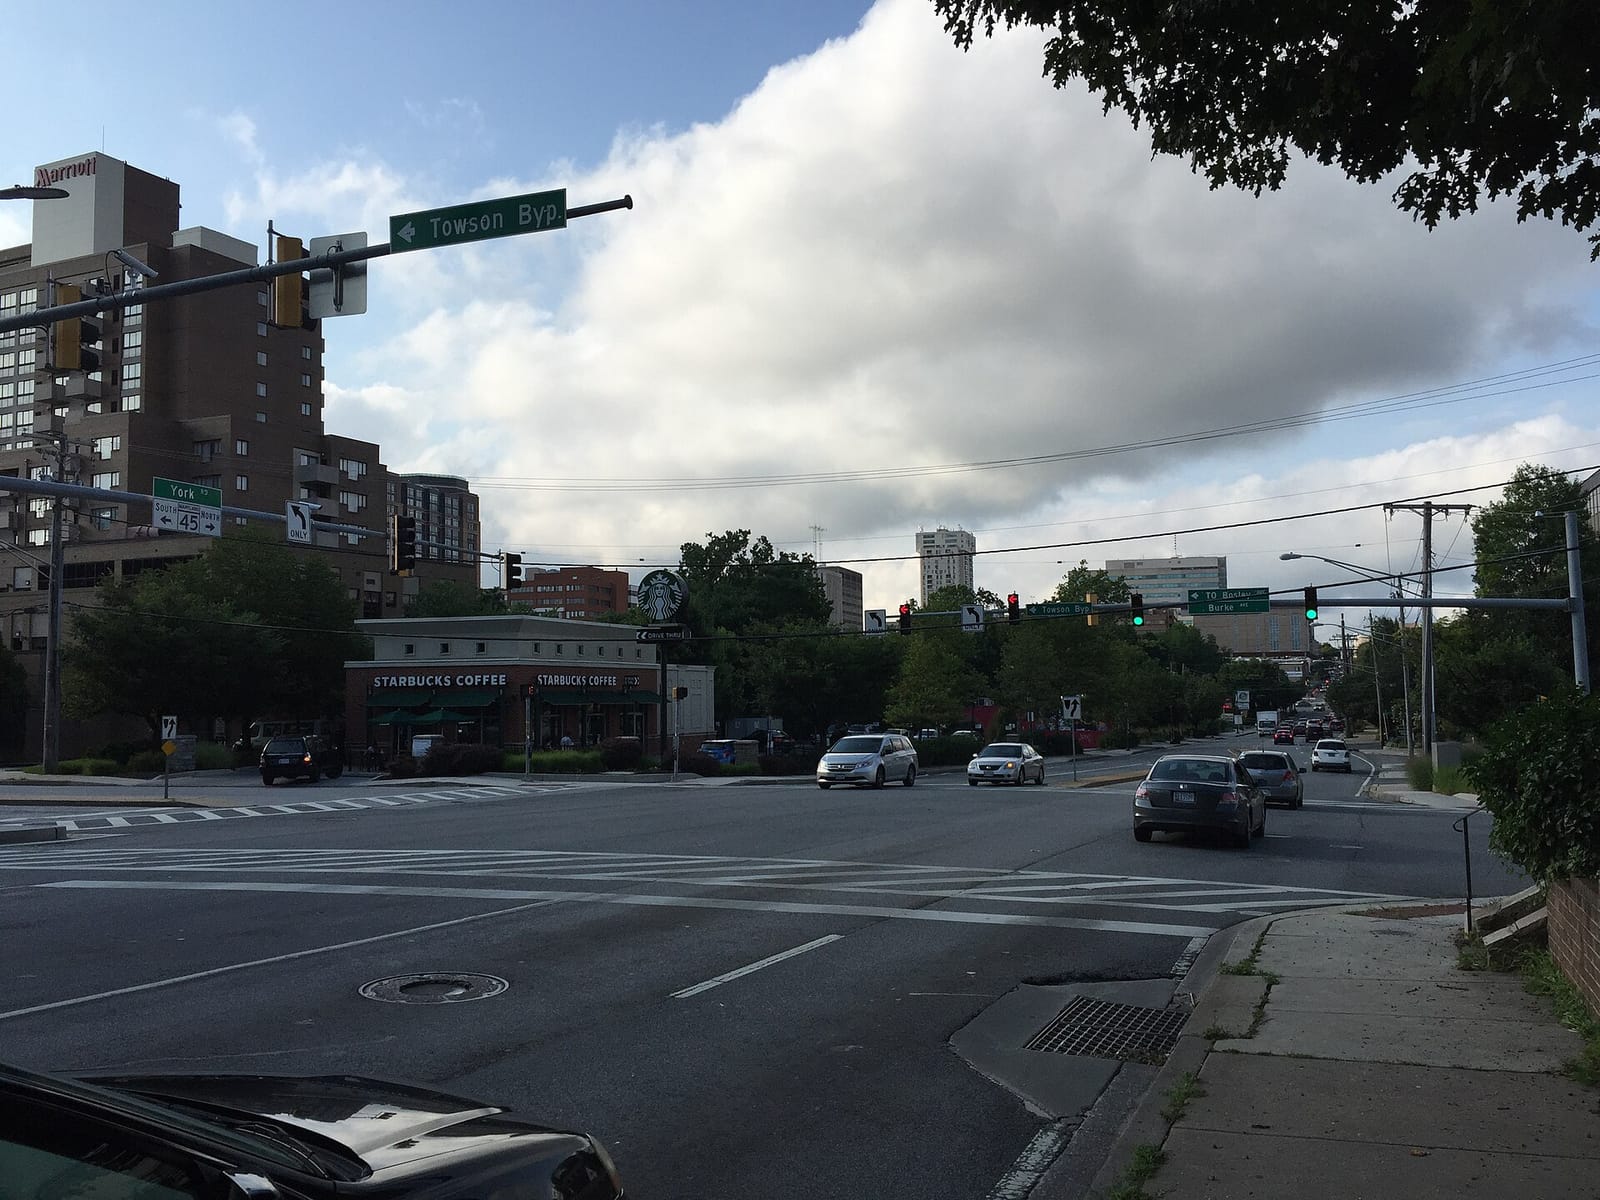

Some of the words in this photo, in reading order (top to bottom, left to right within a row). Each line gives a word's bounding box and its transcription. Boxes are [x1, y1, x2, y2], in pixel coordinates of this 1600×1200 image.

[430, 212, 503, 238] Towson
[170, 485, 194, 500] York
[155, 503, 177, 514] SOUTH
[200, 510, 220, 521] NORTH
[179, 514, 198, 531] 45
[290, 529, 308, 540] ONLY
[1206, 591, 1217, 600] TO
[1042, 606, 1070, 614] Towson
[1208, 604, 1234, 612] Burke
[373, 675, 451, 687] STARBUCKS
[456, 674, 507, 686] COFFEE
[537, 674, 587, 686] STARBUCKS
[588, 675, 617, 686] COFFEE
